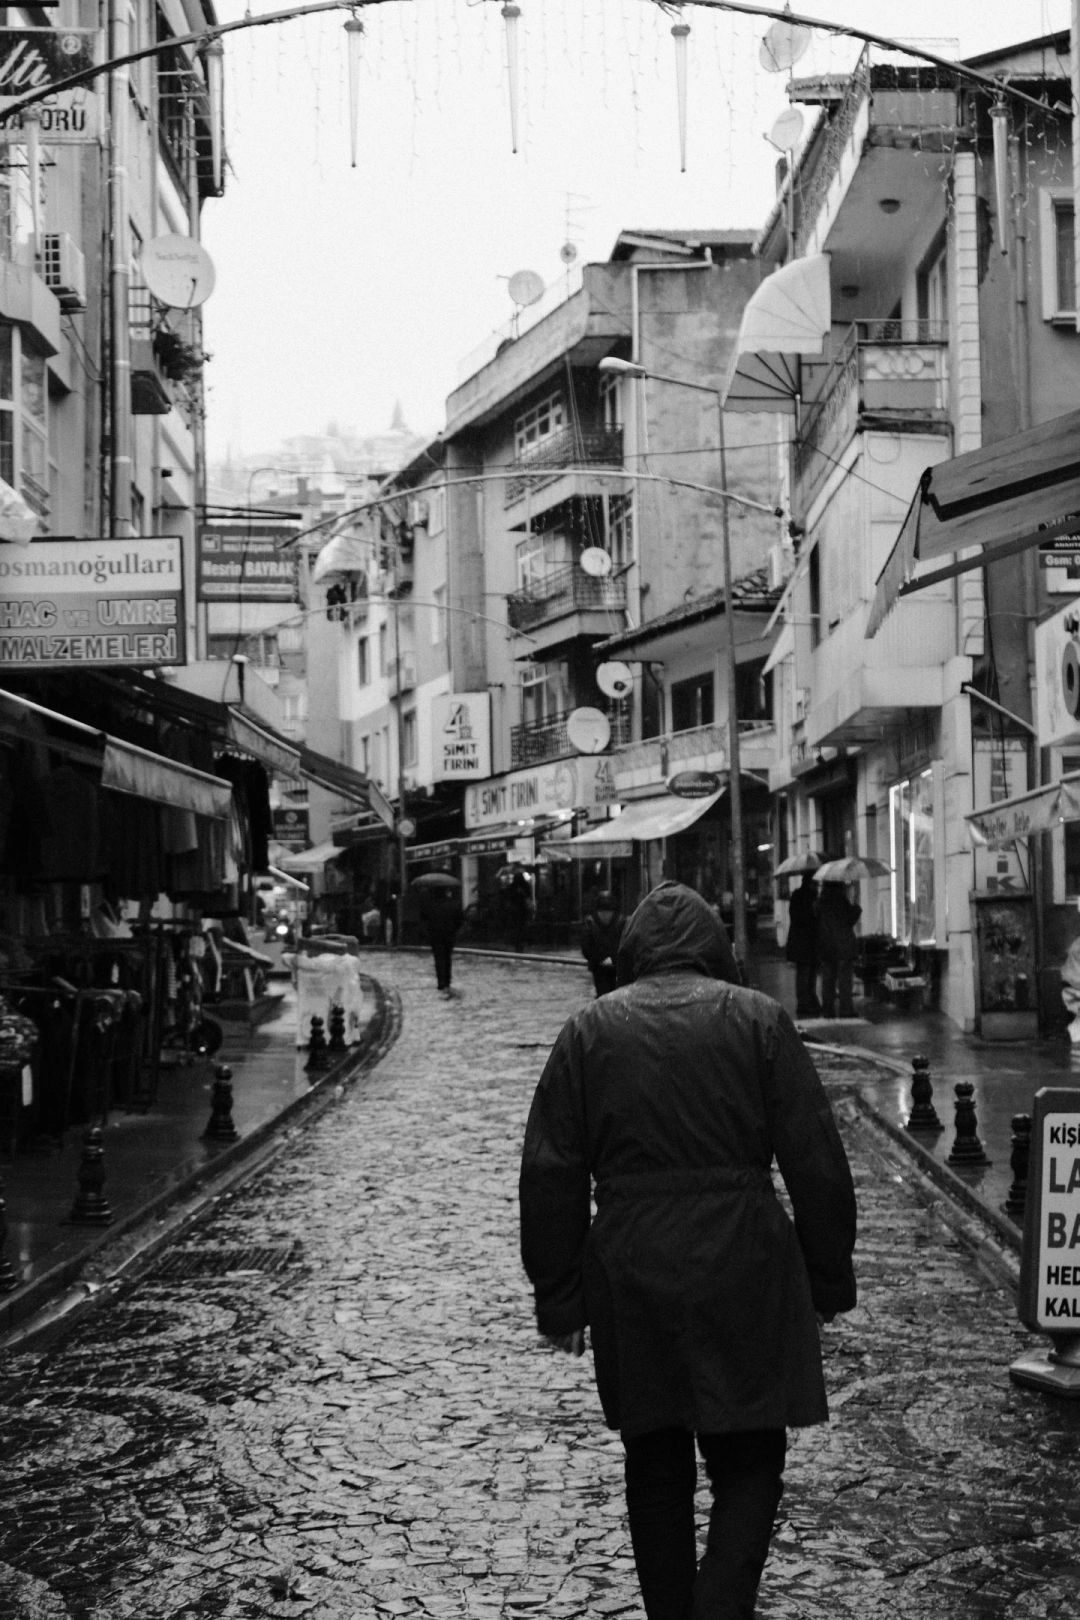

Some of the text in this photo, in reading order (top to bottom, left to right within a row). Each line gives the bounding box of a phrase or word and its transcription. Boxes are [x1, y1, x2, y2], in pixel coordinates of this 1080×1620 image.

[0, 553, 175, 583] osmanoğulları
[202, 560, 294, 577] Nesrin BAYRAK
[1045, 555, 1072, 566] Gsm:
[0, 601, 57, 628] HAC
[97, 598, 178, 626] UMRE
[0, 628, 178, 661] MALZEMELERİ
[1044, 1297, 1080, 1317] KAL
